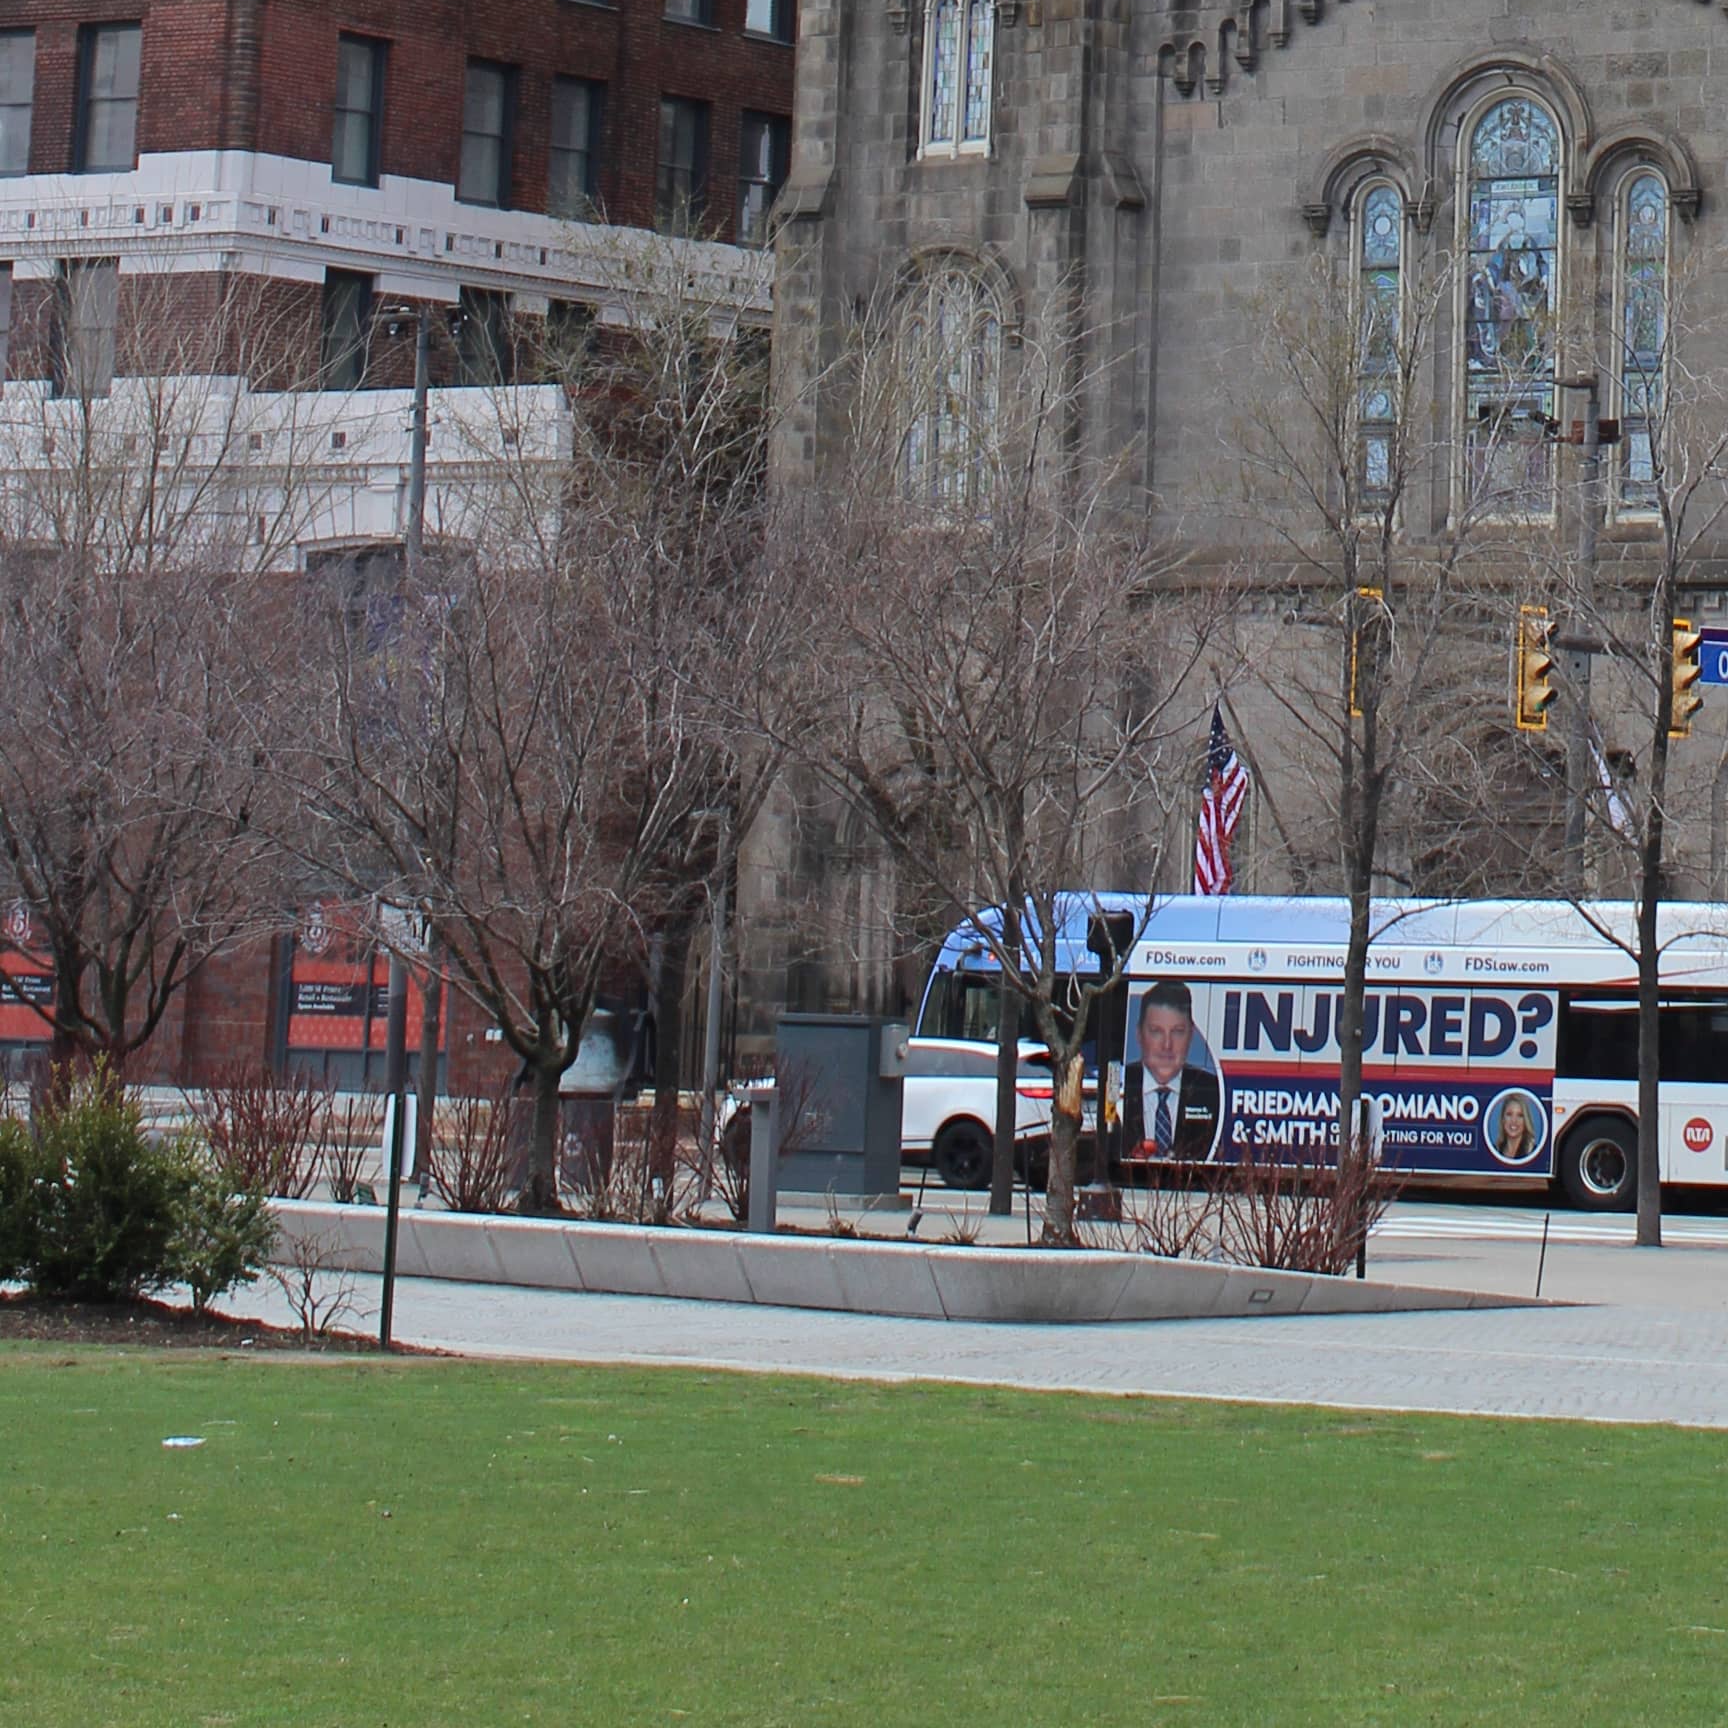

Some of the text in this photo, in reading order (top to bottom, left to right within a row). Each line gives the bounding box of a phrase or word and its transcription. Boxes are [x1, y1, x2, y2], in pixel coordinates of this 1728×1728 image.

[1287, 955, 1345, 968] FIGHTING
[1375, 957, 1400, 969] YOU
[1222, 991, 1554, 1059] INJURED?
[1232, 1089, 1342, 1117] FRIEDMAN
[1232, 1119, 1251, 1144] &
[1253, 1119, 1327, 1146] SMITH
[1421, 1130, 1444, 1144] FOR
[1447, 1132, 1472, 1145] YOU
